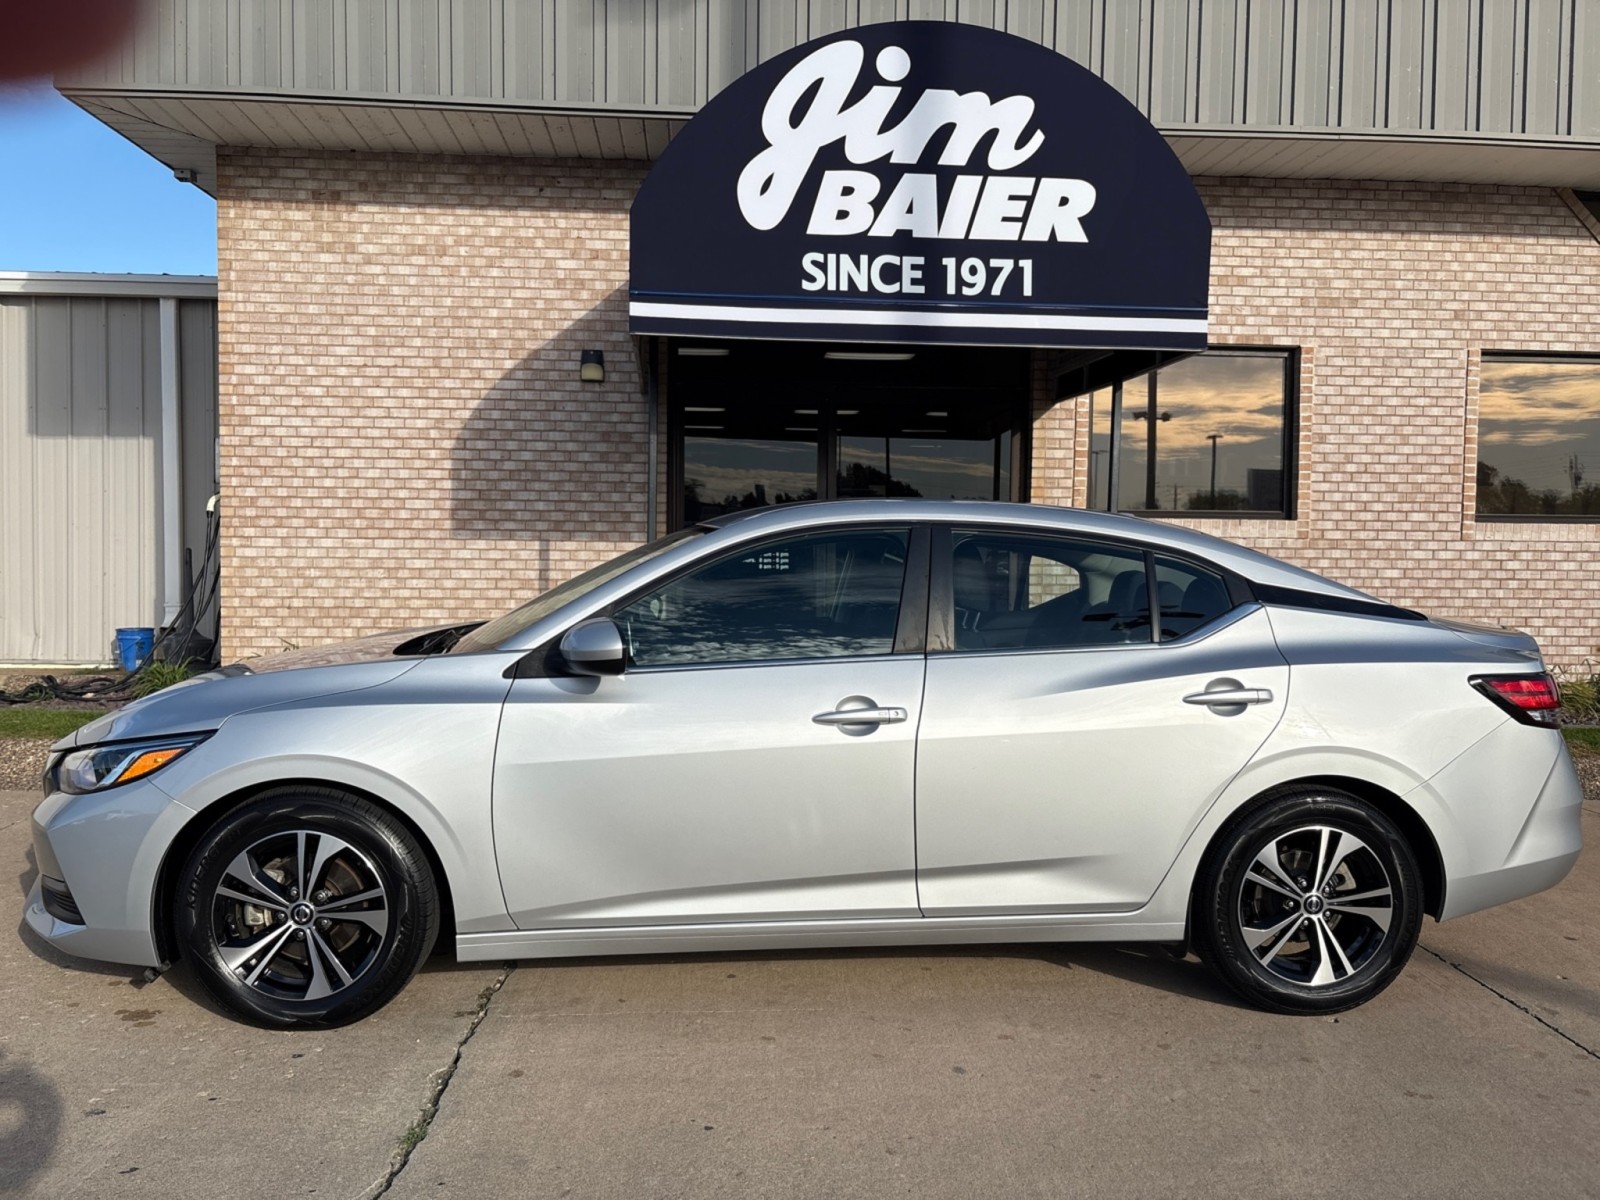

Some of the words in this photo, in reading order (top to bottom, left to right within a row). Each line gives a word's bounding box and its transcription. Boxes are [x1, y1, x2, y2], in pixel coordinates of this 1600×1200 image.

[737, 40, 1045, 231] Jim
[807, 170, 1097, 242] BAIER
[801, 252, 926, 295] SINCE
[942, 257, 1033, 297] 1971
